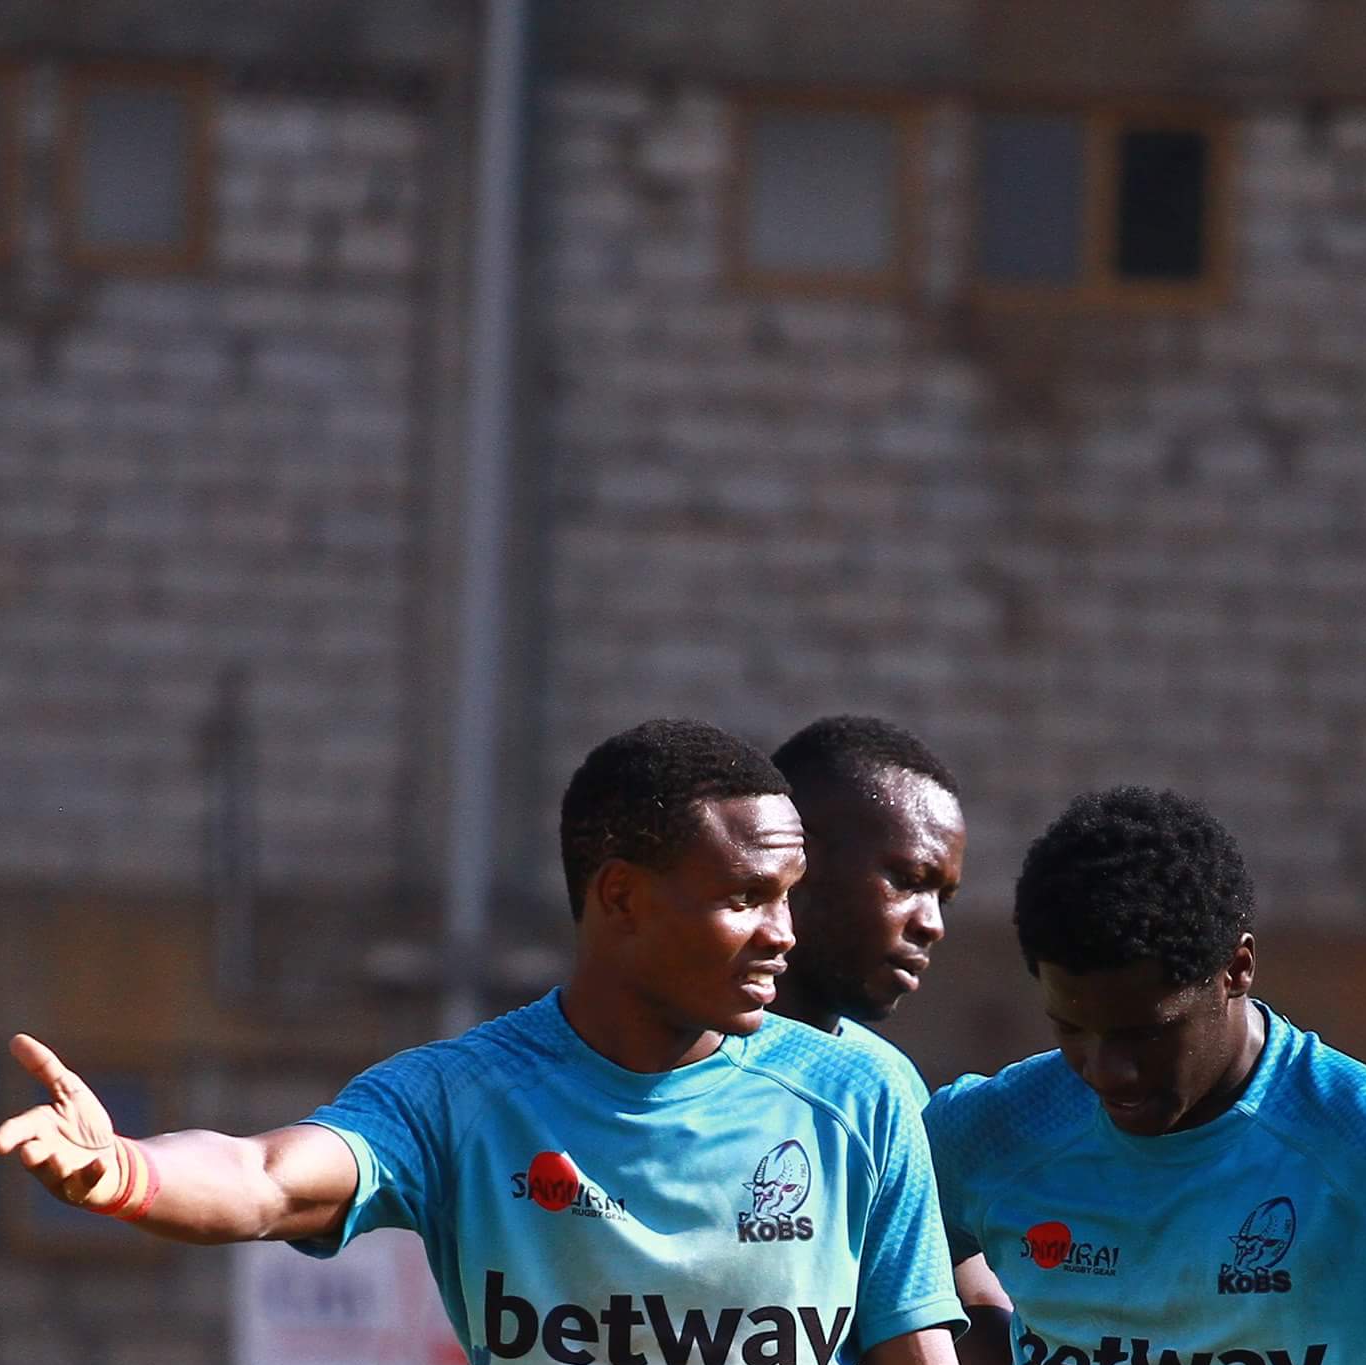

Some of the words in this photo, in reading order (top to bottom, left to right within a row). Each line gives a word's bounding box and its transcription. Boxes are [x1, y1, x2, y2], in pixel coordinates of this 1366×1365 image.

[571, 1207, 602, 1218] RUGBY
[738, 1215, 814, 1243] KOBS
[1019, 1236, 1121, 1268] SAMURAI
[1218, 1269, 1292, 1295] KOBS
